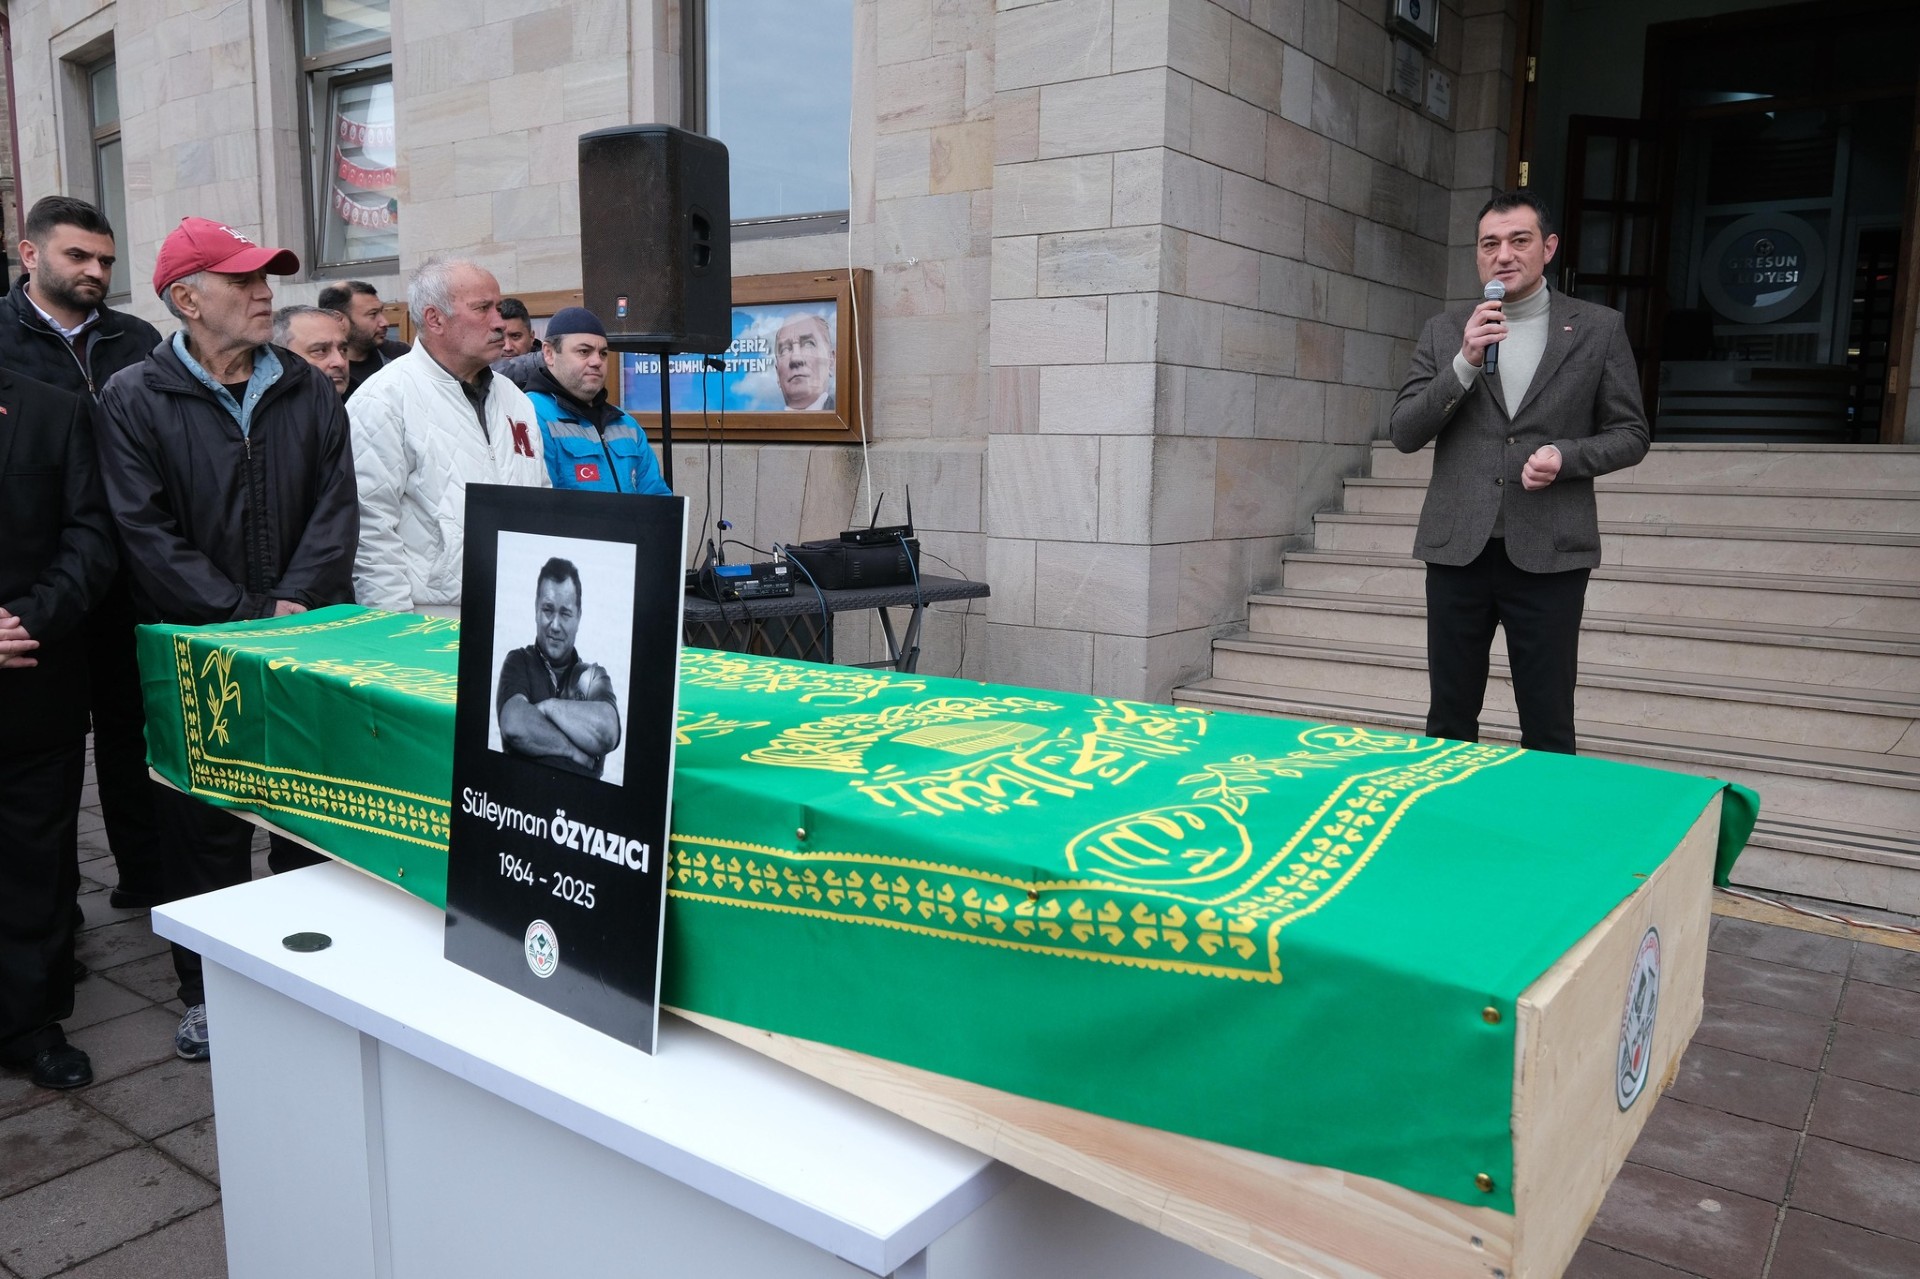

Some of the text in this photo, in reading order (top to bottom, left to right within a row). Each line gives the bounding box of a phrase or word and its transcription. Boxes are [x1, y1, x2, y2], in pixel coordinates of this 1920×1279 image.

[635, 361, 649, 374] NE
[462, 786, 650, 874] Süleyman ÖZYAZICI
[499, 852, 535, 887] 1964
[552, 871, 596, 910] 2025
